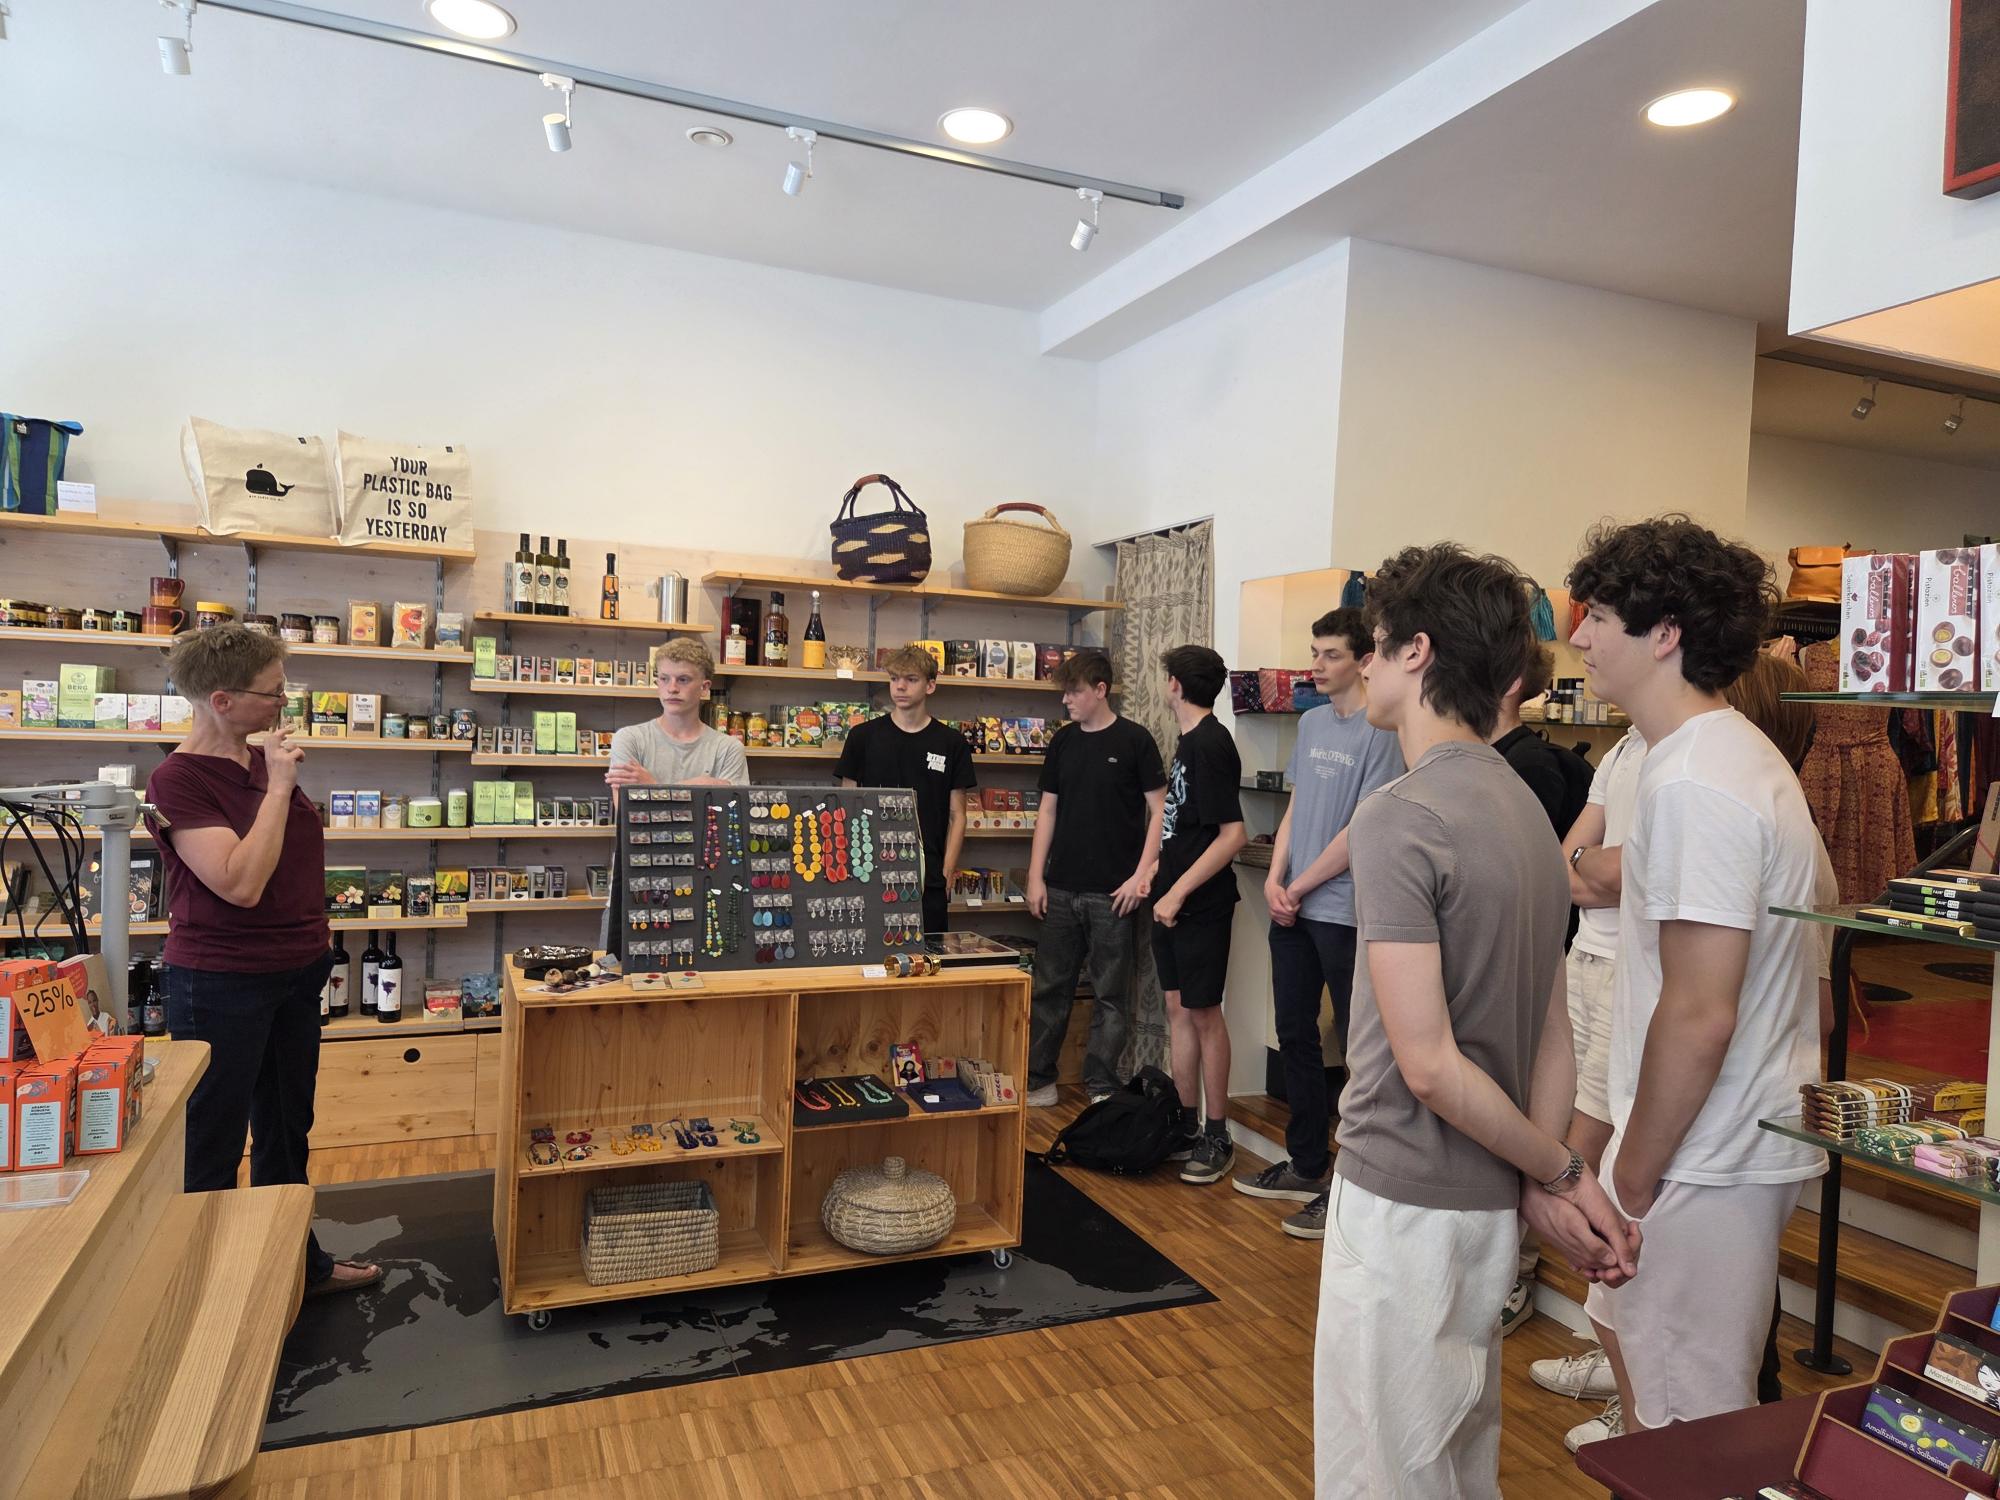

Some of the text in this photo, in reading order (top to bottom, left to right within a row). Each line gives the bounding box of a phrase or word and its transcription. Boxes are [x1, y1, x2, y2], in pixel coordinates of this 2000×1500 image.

[390, 456, 428, 477] YOUR
[363, 473, 453, 501] PLASTIC BAG
[387, 498, 427, 520] IS SO
[365, 518, 447, 543] YESTERDAY
[1924, 577, 1933, 607] Pistazien
[1986, 572, 1994, 604] Pistazien
[23, 983, 74, 1018] -25%
[1928, 1368, 1954, 1383] Mandel
[1865, 1422, 1908, 1448] Amalfizitrone
[1909, 1443, 1915, 1452] &
